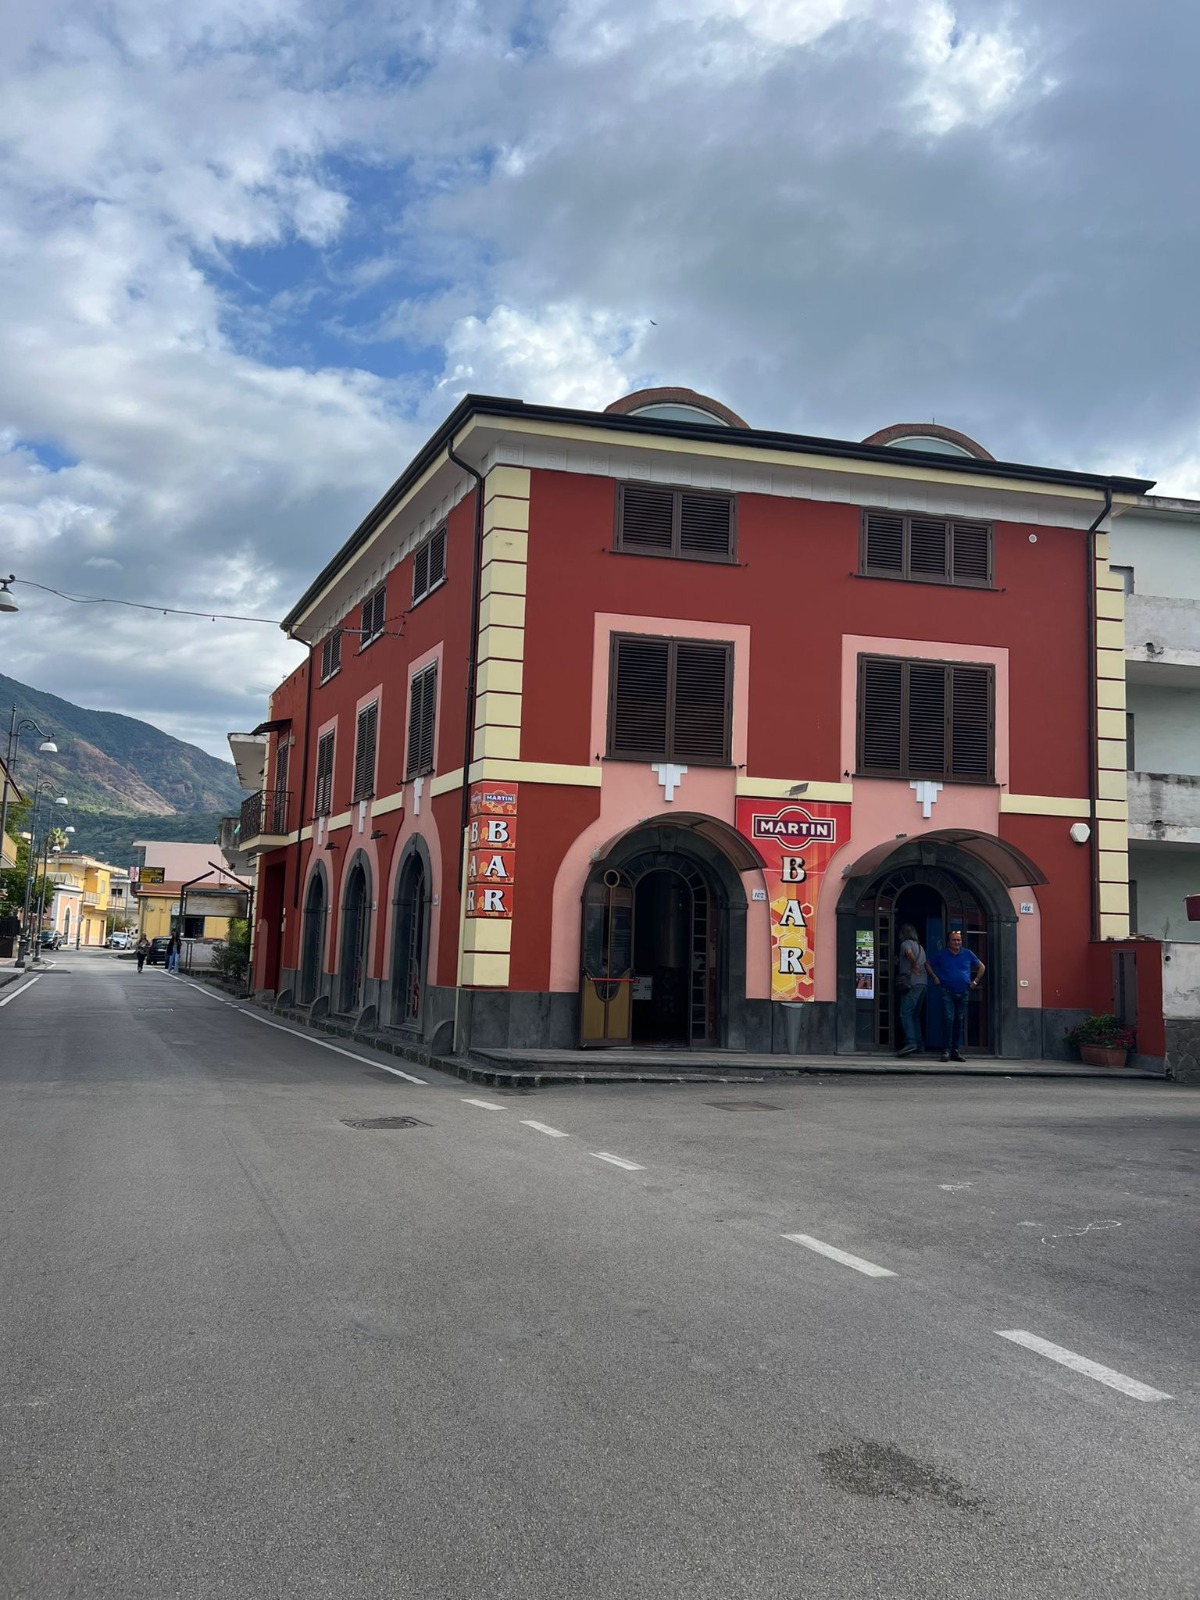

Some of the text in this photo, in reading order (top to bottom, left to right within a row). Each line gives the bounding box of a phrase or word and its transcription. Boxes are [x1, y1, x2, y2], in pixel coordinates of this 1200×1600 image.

[484, 820, 509, 912] BAR
[760, 820, 828, 836] MARTIN
[779, 855, 807, 975] BAR
